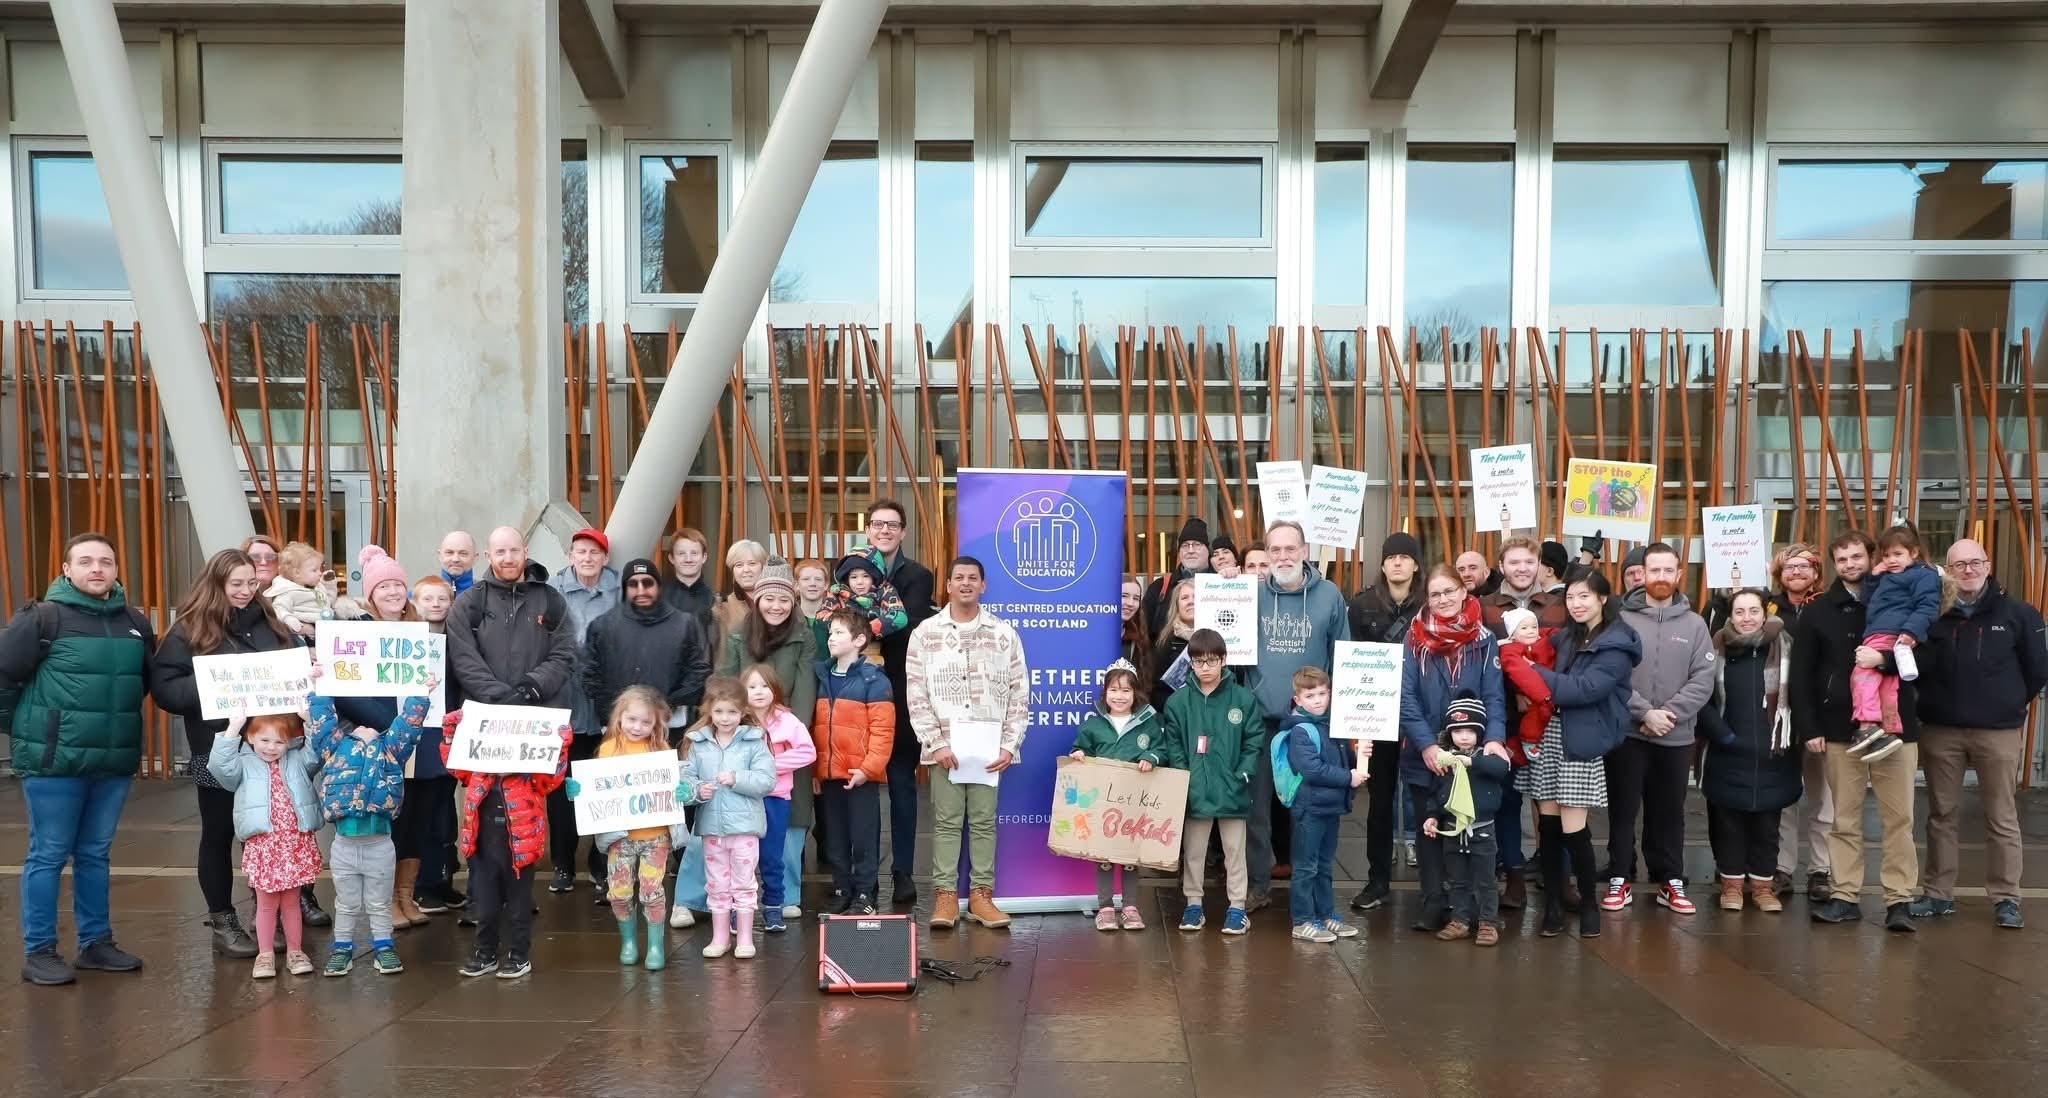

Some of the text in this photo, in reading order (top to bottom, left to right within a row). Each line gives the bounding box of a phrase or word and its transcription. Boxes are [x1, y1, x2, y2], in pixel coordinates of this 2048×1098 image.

[1480, 450, 1525, 463] The family
[1574, 464, 1632, 478] STOP the
[1712, 510, 1756, 522] The family
[1017, 560, 1075, 568] UNITE FOR
[1017, 569, 1075, 577] EDUCATION
[981, 603, 1118, 614] RIST CENTRED EDUCATION
[1004, 619, 1088, 628] OR SCOTLAND
[334, 636, 368, 656] LET
[379, 637, 427, 660] KIDS
[1266, 645, 1287, 653] Family
[1269, 638, 1305, 647] Scottish
[1351, 647, 1390, 657] Parental
[1341, 659, 1397, 672] responsibility
[334, 660, 429, 685] BE KIDS
[1031, 669, 1106, 685] ETHER
[1048, 691, 1093, 705] MAKE
[1338, 686, 1397, 697] gift from God
[479, 719, 553, 736] FAMILIES
[519, 742, 560, 762] BEST
[594, 768, 672, 791] EDUCATION
[1105, 783, 1162, 810] Let Kids
[588, 797, 623, 822] NOT
[998, 814, 1052, 824] EFOREDU
